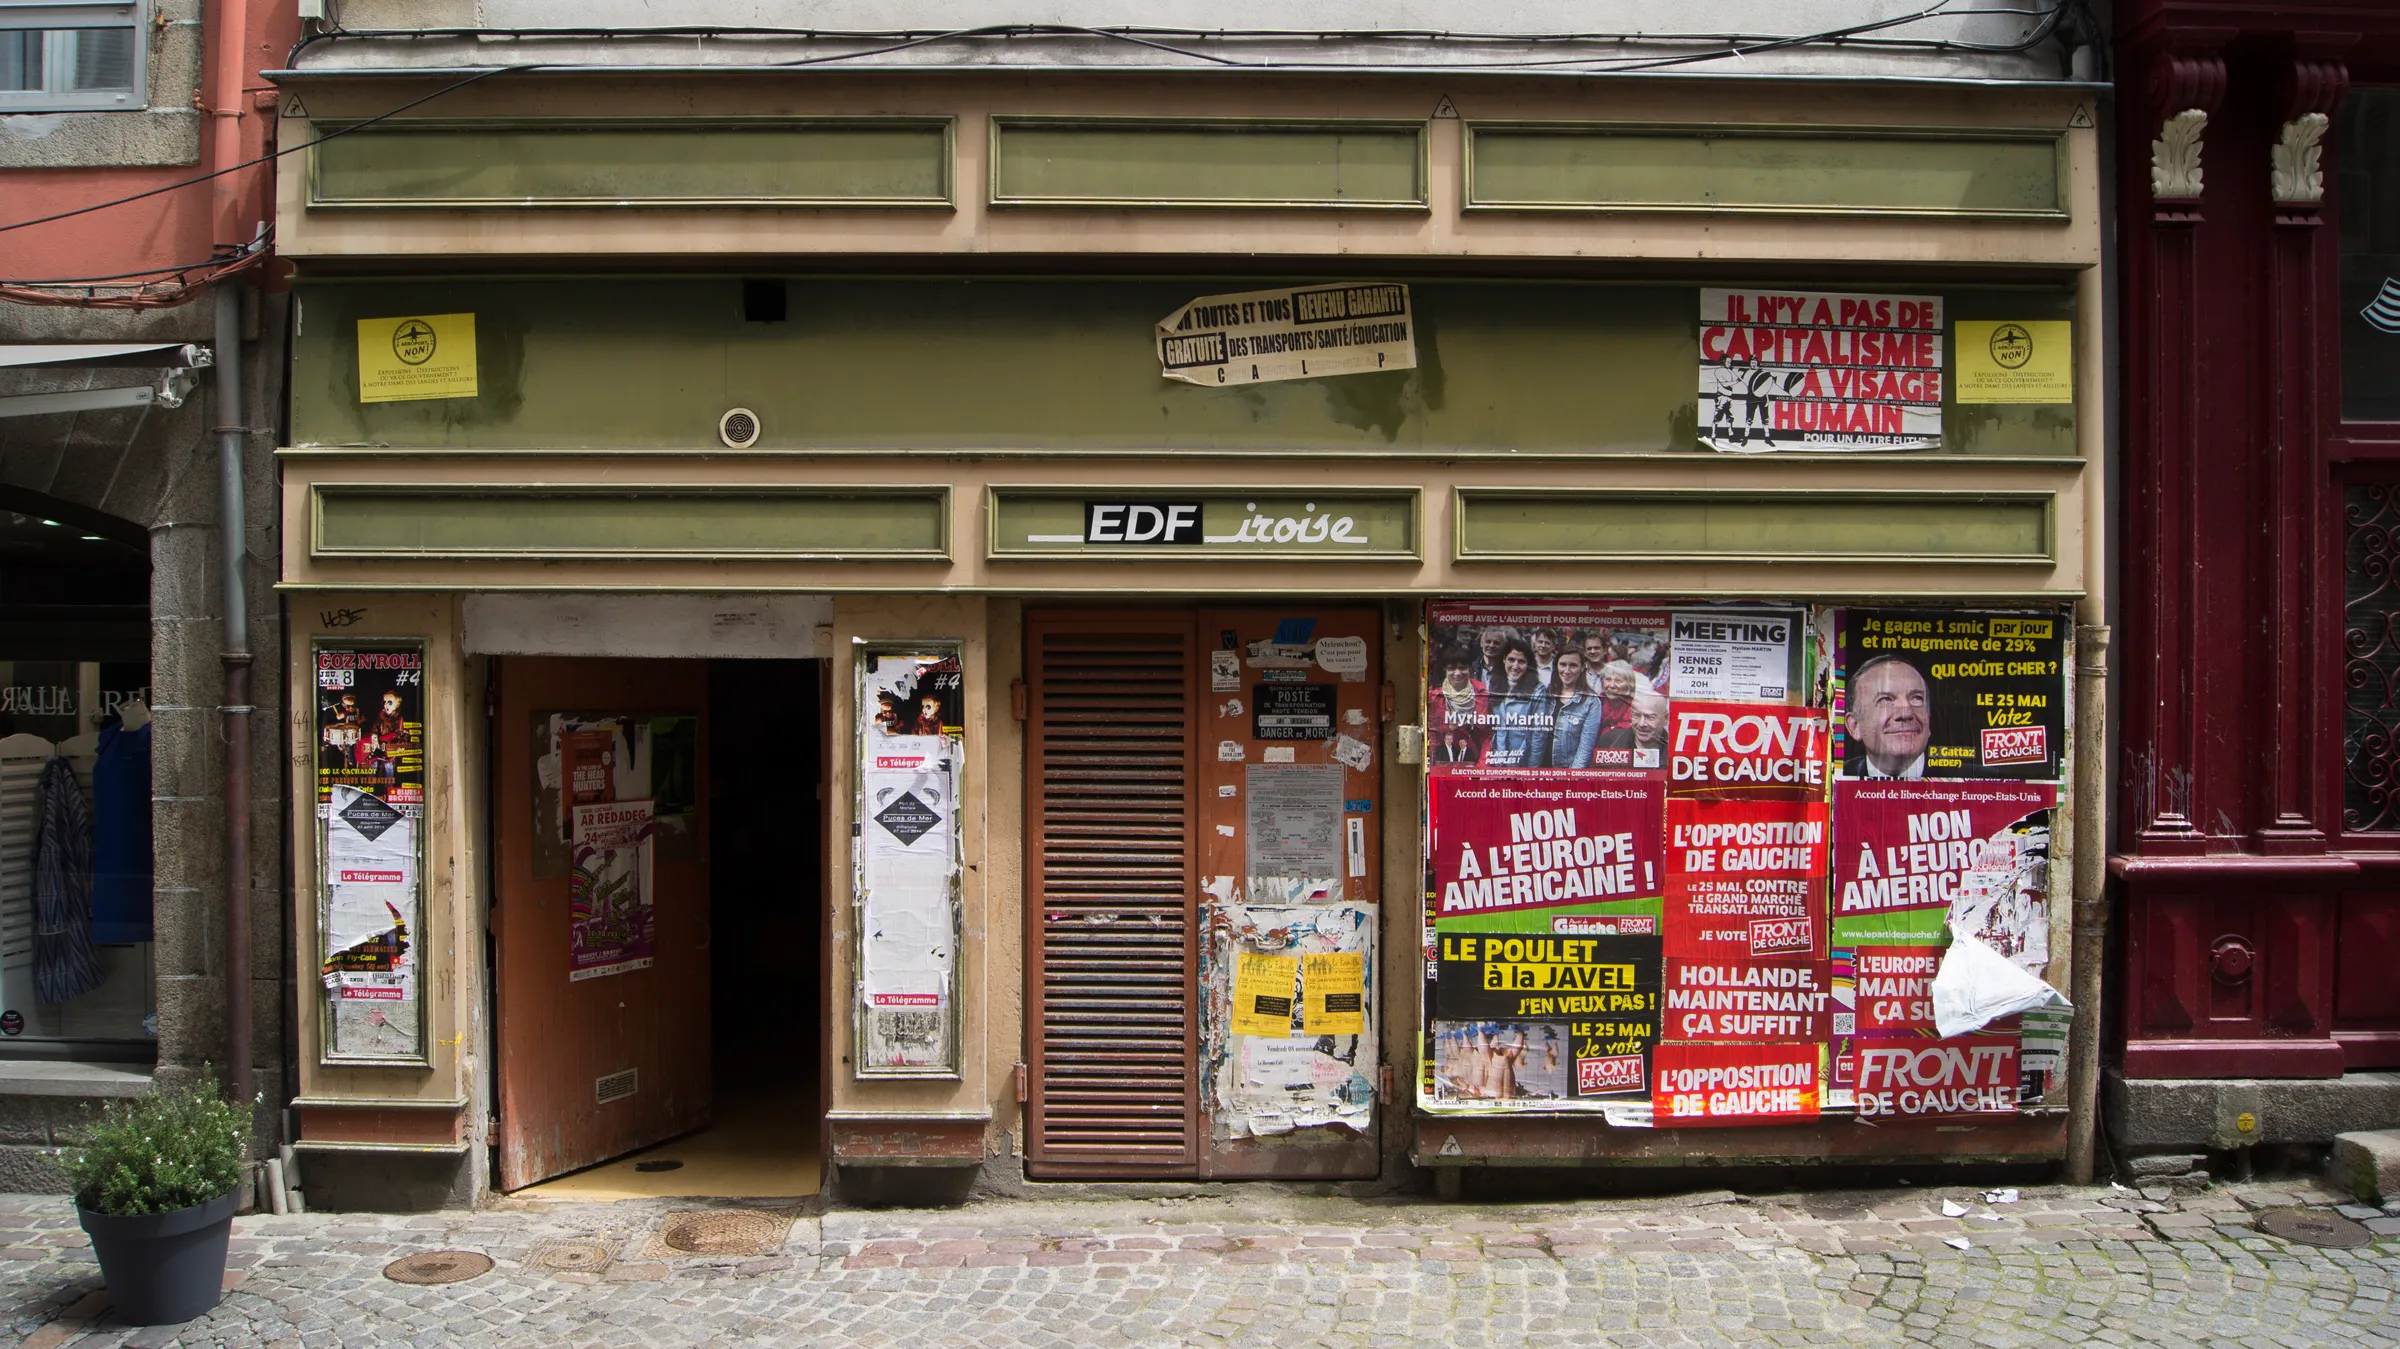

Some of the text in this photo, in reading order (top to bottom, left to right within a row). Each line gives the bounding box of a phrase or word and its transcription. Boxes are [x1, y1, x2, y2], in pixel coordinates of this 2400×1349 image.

[1195, 302, 1241, 330] TOUTES
[1243, 301, 1255, 324] ET
[1258, 298, 1291, 323] TOUS
[1299, 290, 1347, 321] REVENU
[1347, 286, 1403, 317] GARANTI
[1727, 295, 1934, 330] IL N'Y A PAS DE
[1230, 338, 1249, 358] DES
[1702, 326, 1935, 367] CAPITALISME
[1824, 370, 1941, 402] VISAGE
[1774, 401, 1904, 434] HUMAIN
[1804, 433, 1892, 445] POUR UN AUTRE
[1089, 502, 1367, 543] EDF iroise
[1476, 615, 1498, 623] AVEC
[1500, 614, 1551, 623] L'AUSTÉRITÉ
[1554, 616, 1576, 624] POUR
[1578, 617, 1623, 625] REFONDER
[1625, 617, 1665, 625] L'EUROPE
[1863, 618, 2049, 638] Je gagne smic par jour
[1675, 621, 1786, 643] MEETING
[1862, 636, 2035, 653] et m'augmente de 29%
[319, 653, 356, 669] COZ
[1679, 656, 1722, 666] RENNES
[1931, 660, 2046, 679] QUI COÛTE CHER
[343, 671, 352, 685] 8
[396, 670, 421, 686] #4
[1682, 666, 1718, 675] 22 MAI
[934, 673, 960, 690] #4
[1691, 680, 1708, 688] 20H
[1278, 691, 1311, 702] POSTE
[1977, 694, 2047, 707] LE 25 MAI
[1444, 711, 1554, 726] Myriam Martin
[1987, 709, 2033, 726] Votez
[1261, 727, 1329, 738] DANGER MORT
[1674, 713, 1828, 757] FRONT
[1985, 730, 2042, 749] FRONT
[1941, 746, 1975, 757] Gattaz
[1985, 746, 2042, 759] DE GAUCHE
[1672, 756, 1822, 785] DE GAUCHE
[1928, 759, 1962, 768] (MEDEF)
[573, 769, 605, 781] THE HEAD
[573, 779, 606, 792] HUNTERS
[1455, 788, 1648, 801] Accord de libre-échange Europe-Etats-Unis
[1855, 789, 2041, 803] Accord de libre-échange Europe-Etats-Unis
[581, 814, 594, 826] AR
[597, 809, 646, 825] REDADEG
[1510, 808, 1576, 842] NON
[1674, 821, 1822, 848] L'OPPOSITION
[1908, 809, 1972, 844] NON
[1459, 833, 1635, 879] À L'EUROPE
[1685, 847, 1812, 872] DE GAUCHE
[1858, 842, 1881, 879] À
[354, 872, 402, 882] Télégramme
[1443, 862, 1636, 912] AMERICAINE
[1699, 879, 1808, 894] 25 CONTRE
[1693, 893, 1802, 905] LE GRAND MARCHÉ
[1688, 903, 1806, 917] TRANSATLANTIQUE
[1620, 919, 1652, 927] FRONT
[1753, 921, 1809, 939] FRONT
[1699, 931, 1747, 941] JE VOTE
[1753, 936, 1810, 949] DE GAUCHE
[1841, 930, 1941, 942] www.lepartidegauche.fr
[1444, 938, 1598, 962] LE POULET
[1860, 956, 1934, 974] L'EUROPE
[1488, 965, 1633, 989] à la JAVEL
[1681, 966, 1819, 991] HOLLANDE,
[354, 988, 402, 999] Télégramme
[876, 995, 937, 1005] Le Télégramme
[1668, 989, 1829, 1012] MAINTENANT
[1517, 993, 1646, 1016] J'EN VEUX PAS
[1873, 1001, 1904, 1025] ÇA
[1572, 1023, 1651, 1037] LE 25 MAI
[1683, 1014, 1801, 1037] ÇA SUFFIT
[1576, 1036, 1644, 1058] Je vote
[1581, 1059, 1640, 1078] FRONT
[1859, 1046, 2015, 1088] FRONT
[1581, 1074, 1640, 1088] DE GAUCHE
[1661, 1063, 1811, 1092] L'OPPOSITION
[1673, 1088, 1801, 1117] DE GAUCHE
[1858, 1086, 2014, 1116] DE GAUCHE
